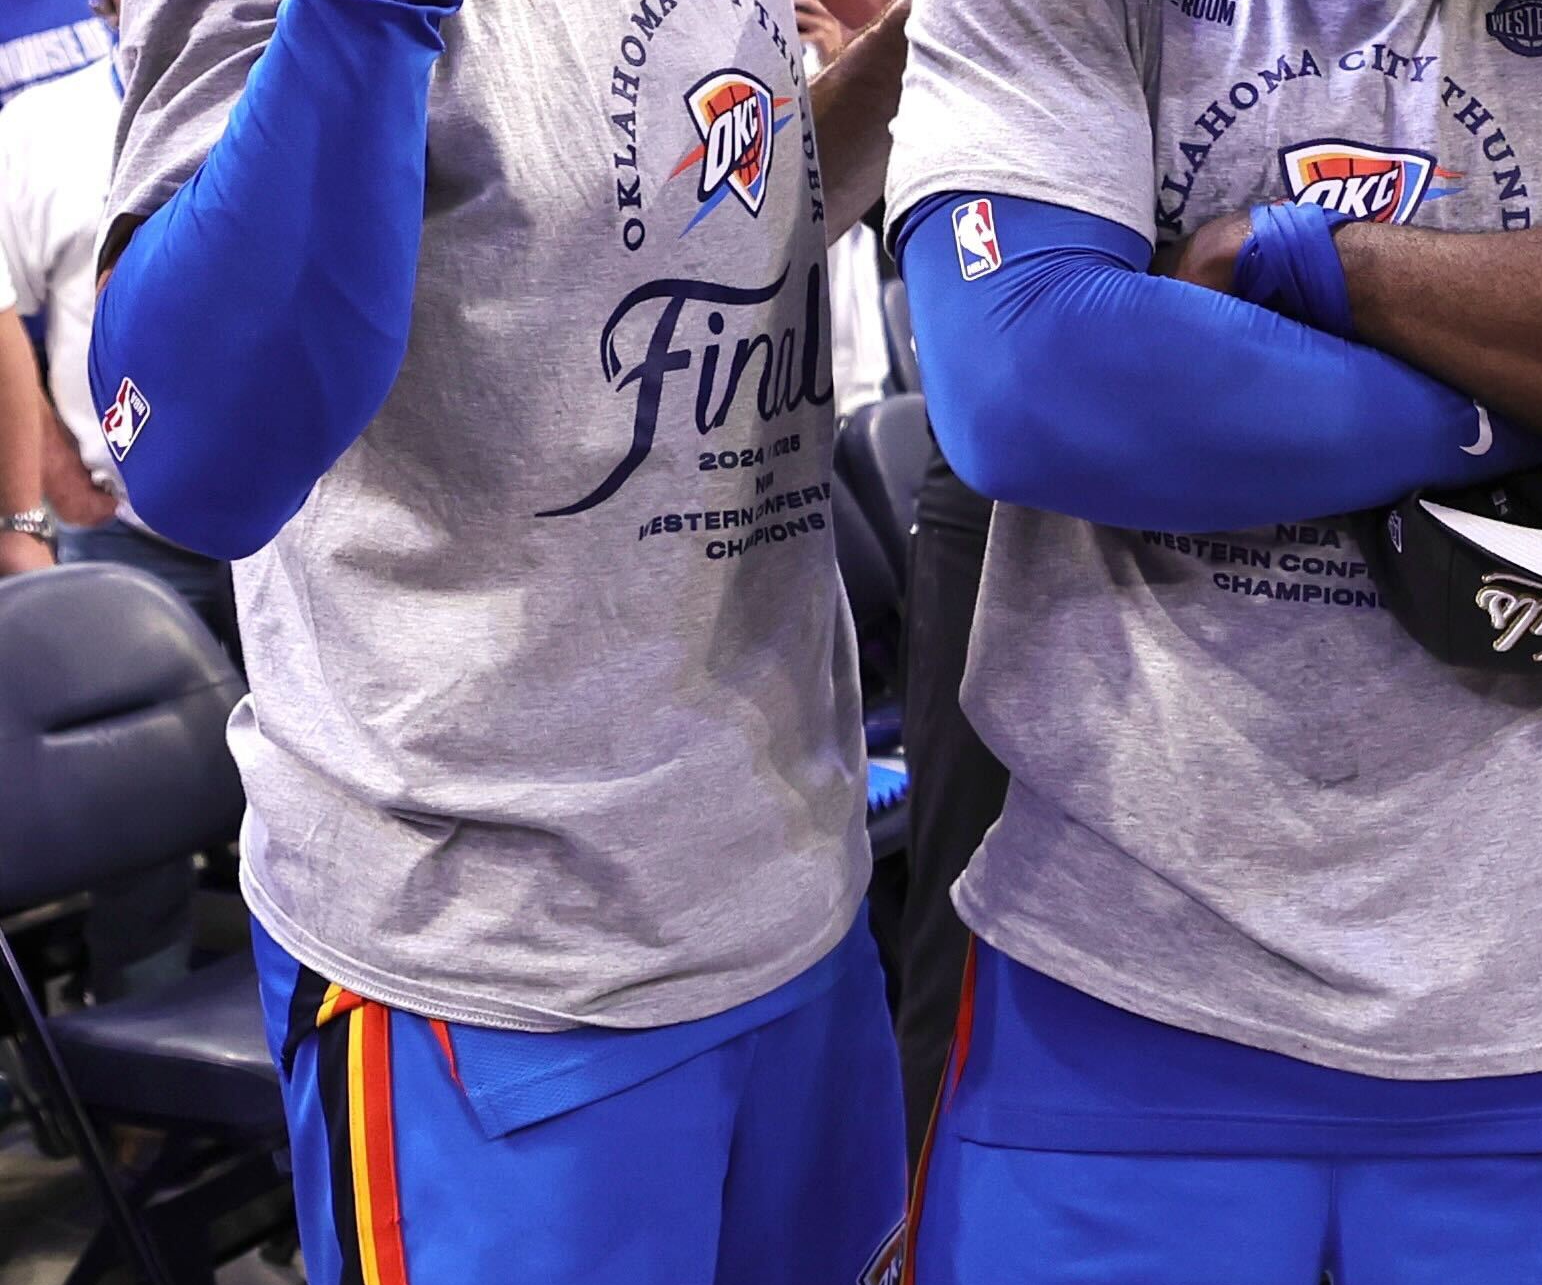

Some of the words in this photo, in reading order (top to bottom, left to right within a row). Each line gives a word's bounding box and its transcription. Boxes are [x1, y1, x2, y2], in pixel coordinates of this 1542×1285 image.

[704, 93, 759, 194] OKC
[1156, 49, 1322, 236] KLAHOMA
[1338, 43, 1439, 84] CITY
[1441, 76, 1531, 232] THUND
[534, 261, 834, 518] Final
[1141, 530, 1271, 570] WESTERN
[1276, 523, 1342, 549] NBA
